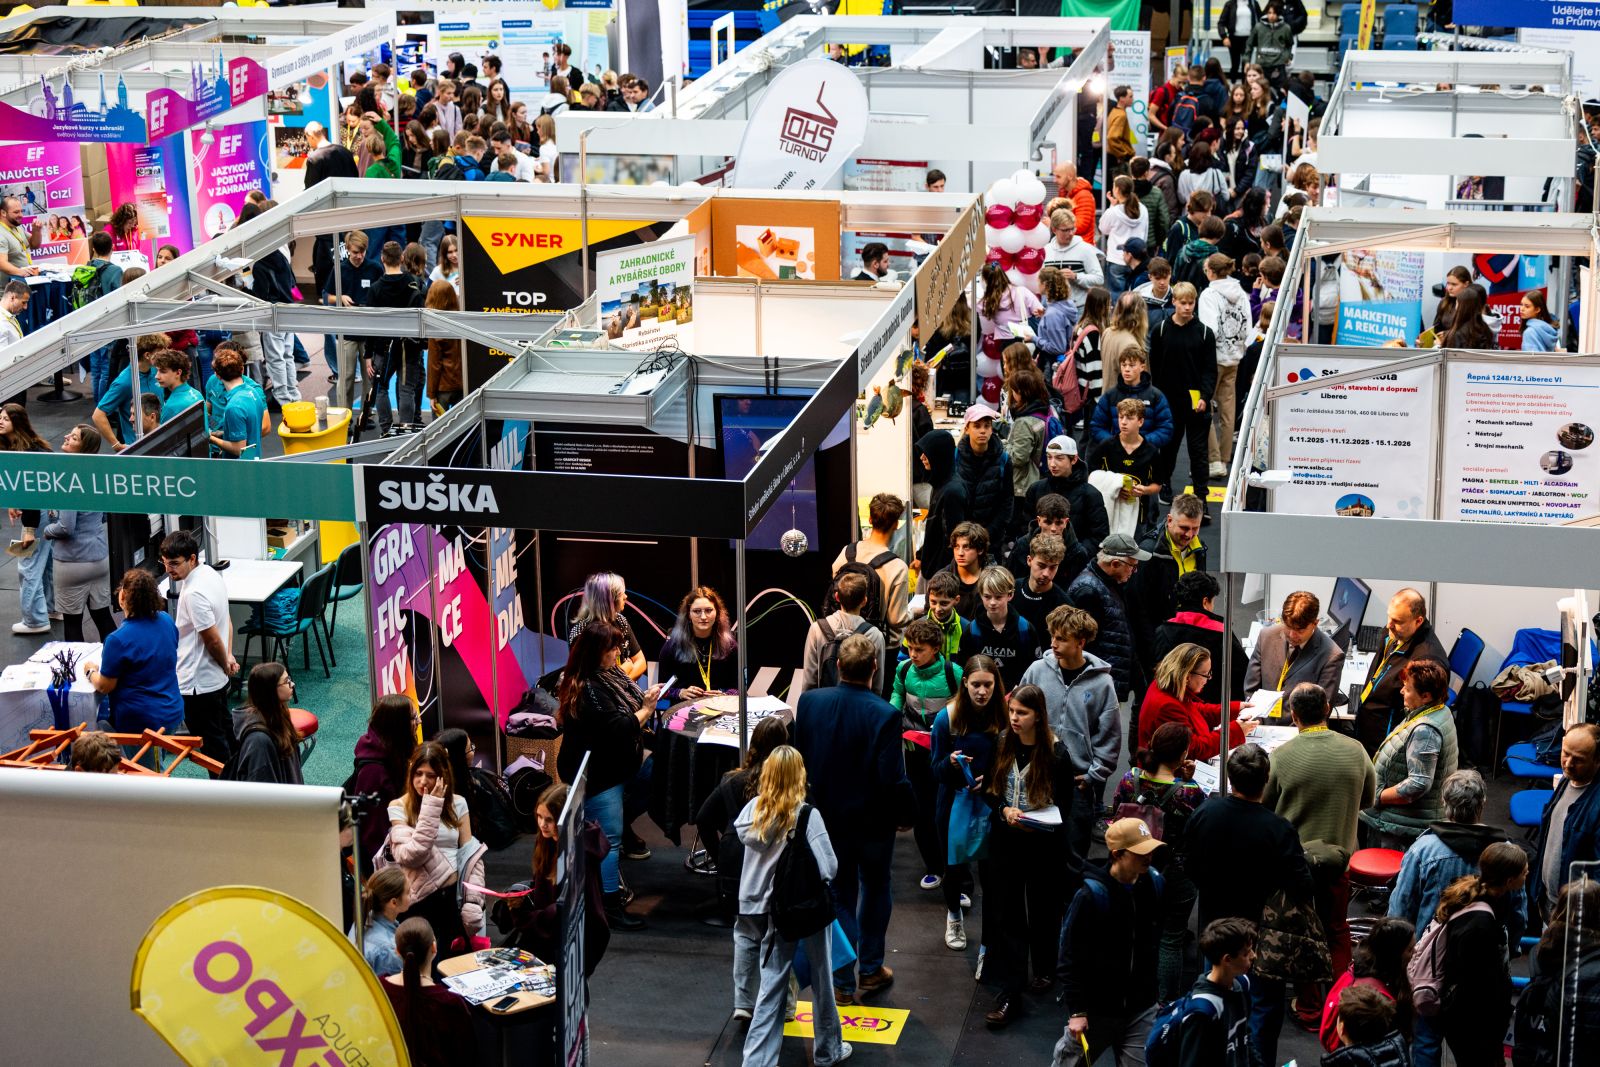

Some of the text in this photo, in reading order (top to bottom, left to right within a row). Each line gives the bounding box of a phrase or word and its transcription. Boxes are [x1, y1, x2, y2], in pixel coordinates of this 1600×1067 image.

[1553, 6, 1593, 19] Udělejte
[232, 64, 248, 97] EF
[151, 96, 168, 131] EF
[27, 147, 45, 160] EF
[220, 134, 242, 154] EF
[779, 139, 826, 164] TURNOV
[0, 166, 59, 180] NAUČTE SE
[211, 160, 255, 177] JAZYKOVÉ
[217, 173, 249, 185] POBYTY
[50, 188, 72, 199] CIZÍ
[208, 178, 262, 197] V ZAHRANIČÍ
[30, 244, 71, 257] HRANIČÍ
[491, 232, 563, 248] SYNER
[620, 248, 675, 269] ZAHRADNICKÉ
[609, 262, 686, 286] A RYBÁŘSKÉ OBORY
[502, 291, 547, 306] TOP
[1344, 307, 1407, 327] MARKETING
[1344, 319, 1352, 330] A
[1356, 321, 1406, 340] REKLAMA
[1467, 373, 1490, 382] Řepná
[1386, 386, 1418, 394] dopravní
[490, 427, 522, 470] MUL
[92, 473, 197, 498] LIBEREC
[378, 472, 499, 514] SUŠKA
[374, 523, 414, 585] GRA
[438, 534, 466, 592] MA
[496, 540, 518, 597] ME
[377, 586, 407, 649] FIC
[441, 594, 463, 648] CE
[498, 593, 524, 652] DIA
[382, 633, 408, 696] KÝ
[795, 1013, 880, 1028] EXO
